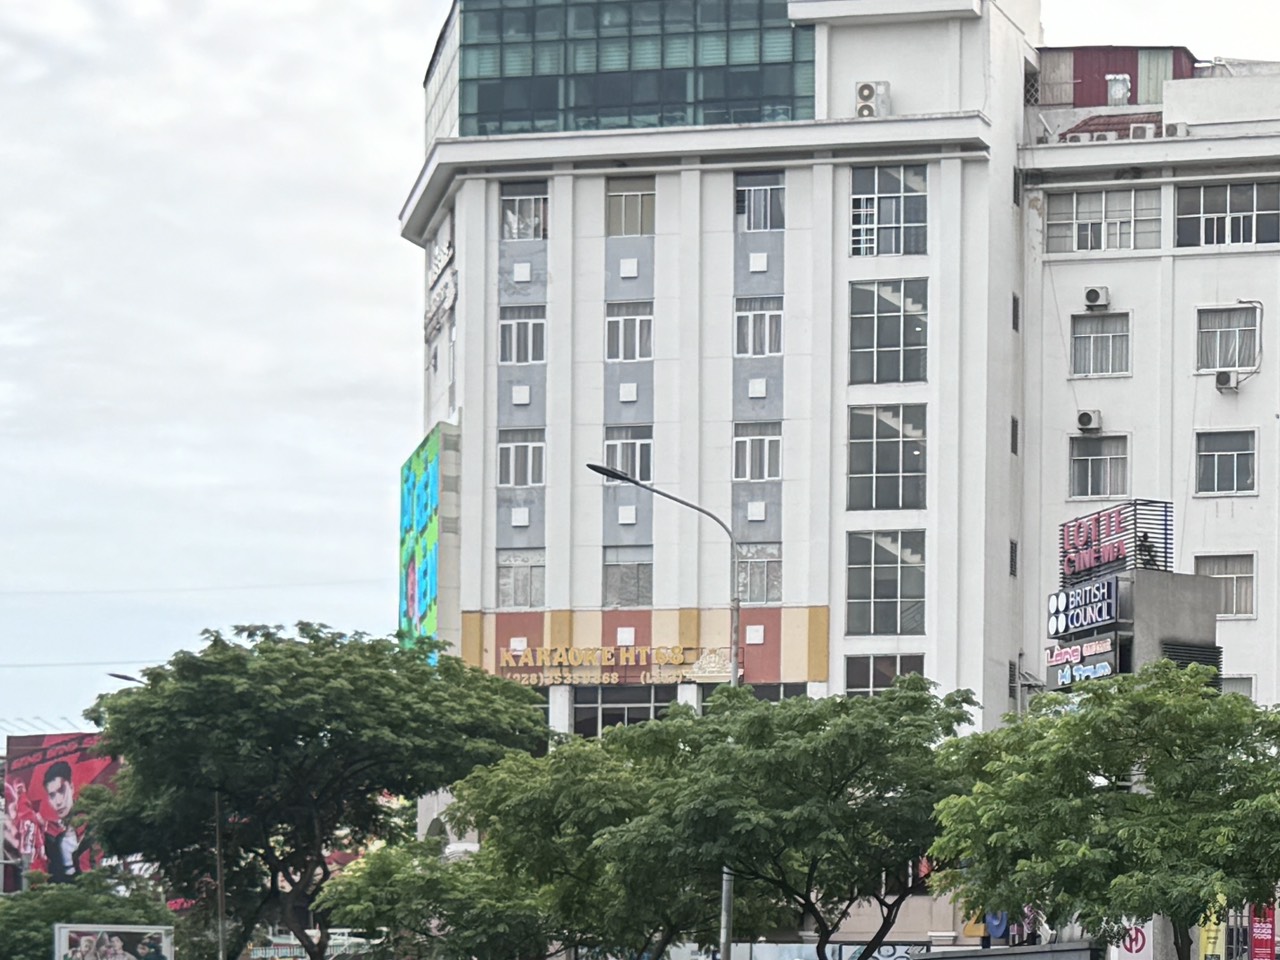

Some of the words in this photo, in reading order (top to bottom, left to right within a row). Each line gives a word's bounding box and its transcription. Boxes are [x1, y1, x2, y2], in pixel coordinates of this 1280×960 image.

[1064, 508, 1126, 550] LOTTE
[1064, 539, 1127, 576] CINEMA
[1069, 581, 1108, 610] BRITISH
[1068, 600, 1111, 629] COUNCIL
[500, 647, 611, 667] KARAOKE
[619, 648, 650, 666] HT
